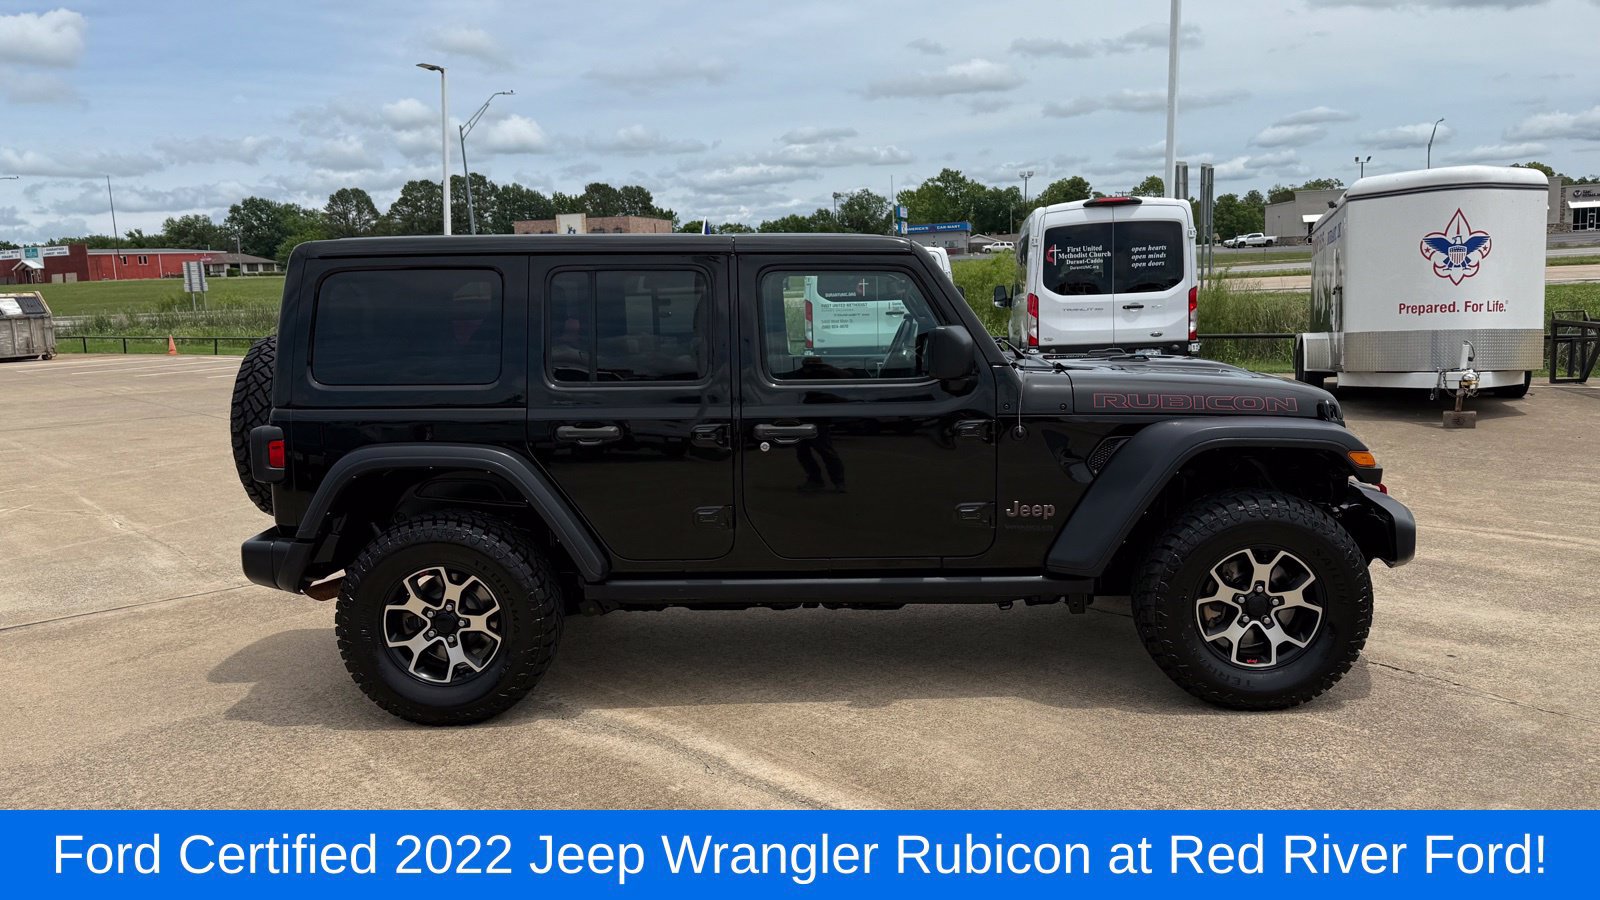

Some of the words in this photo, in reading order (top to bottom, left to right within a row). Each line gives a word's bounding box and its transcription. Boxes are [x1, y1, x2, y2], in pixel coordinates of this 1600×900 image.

[1088, 250, 1112, 258] Church
[1147, 251, 1167, 259] minds
[1398, 301, 1460, 316] Prepared.
[1464, 300, 1484, 313] For
[1094, 393, 1298, 412] RUBICON
[1005, 500, 1056, 520] Jeep
